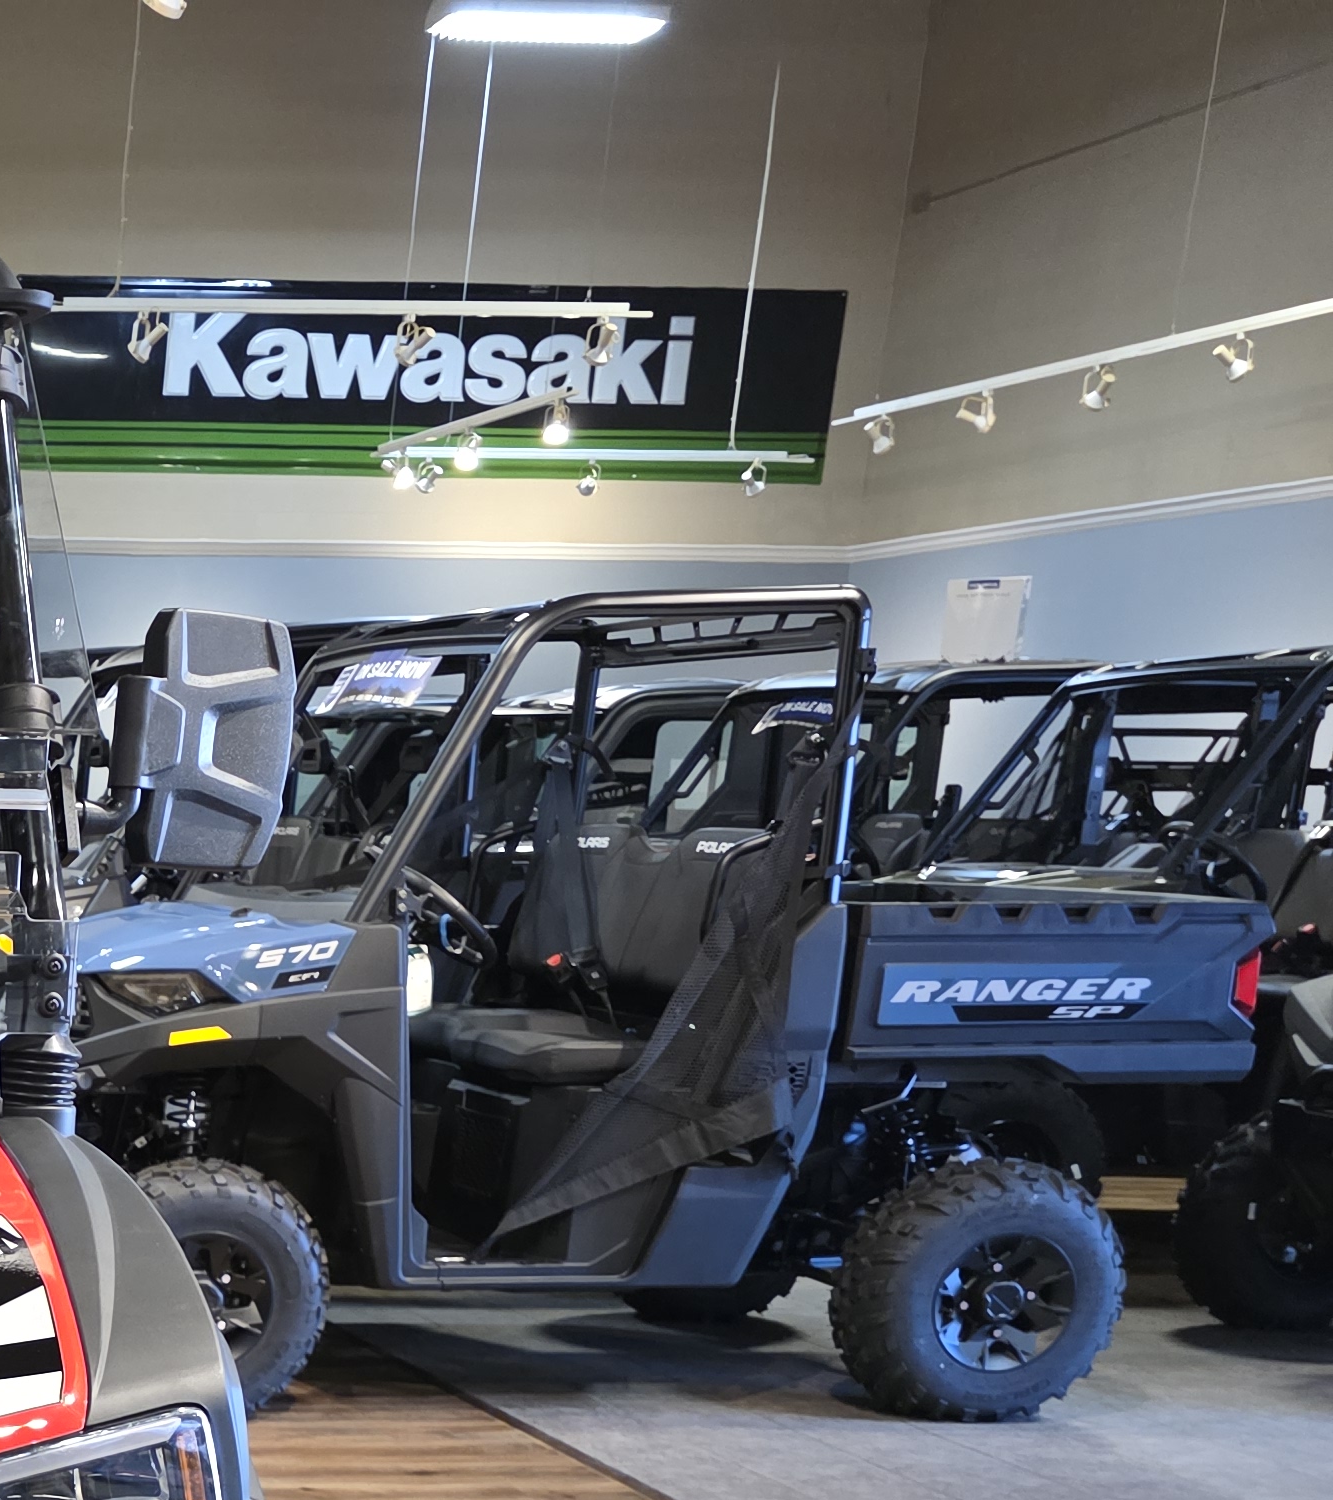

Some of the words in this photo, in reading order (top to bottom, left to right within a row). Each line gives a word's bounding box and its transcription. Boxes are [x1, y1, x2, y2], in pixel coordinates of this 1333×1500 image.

[162, 312, 696, 405] Kawasaki
[255, 940, 339, 969] 570
[890, 977, 1152, 1003] RANGER
[1048, 1005, 1125, 1019] SP
